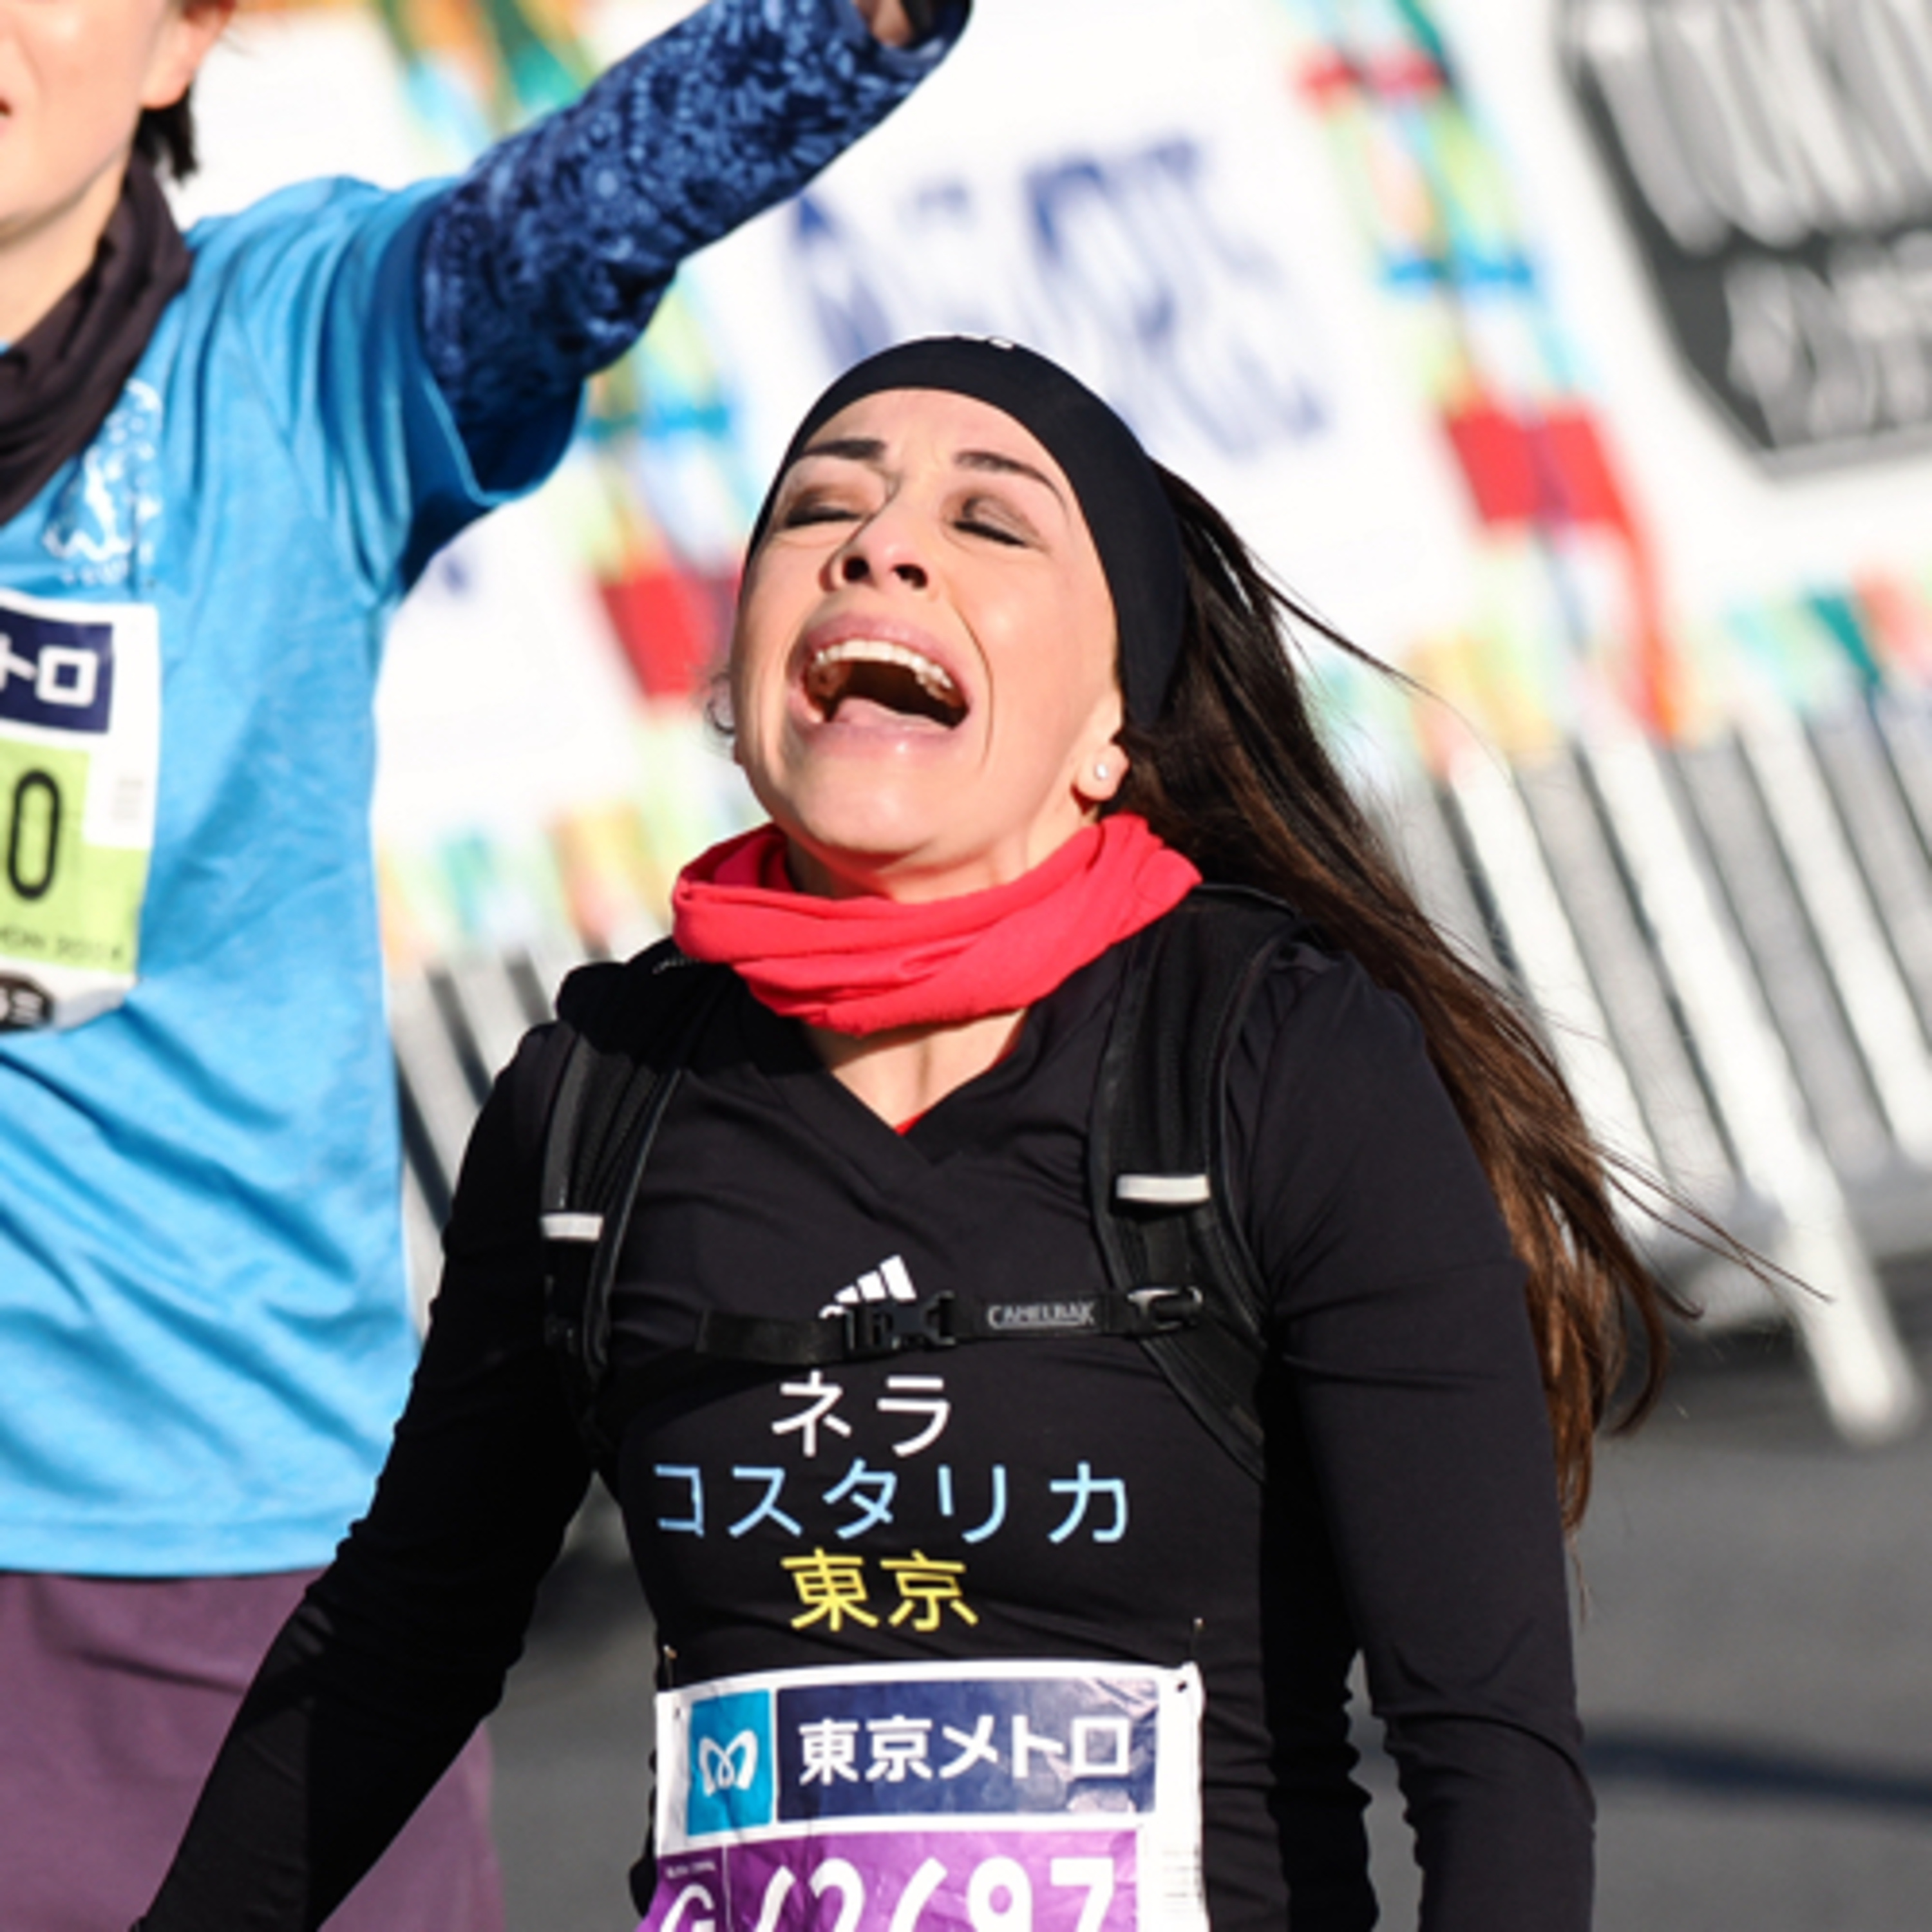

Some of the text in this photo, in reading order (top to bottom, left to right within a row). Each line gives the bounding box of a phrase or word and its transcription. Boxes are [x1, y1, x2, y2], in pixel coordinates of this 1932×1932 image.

[7, 768, 61, 901] 0
[987, 1302, 1095, 1330] CAMELBAK
[772, 1370, 951, 1457] ネラ
[654, 1458, 1129, 1544] コスタリカ
[781, 1547, 979, 1632] 東京
[799, 1715, 1132, 1785] 東京メトロ
